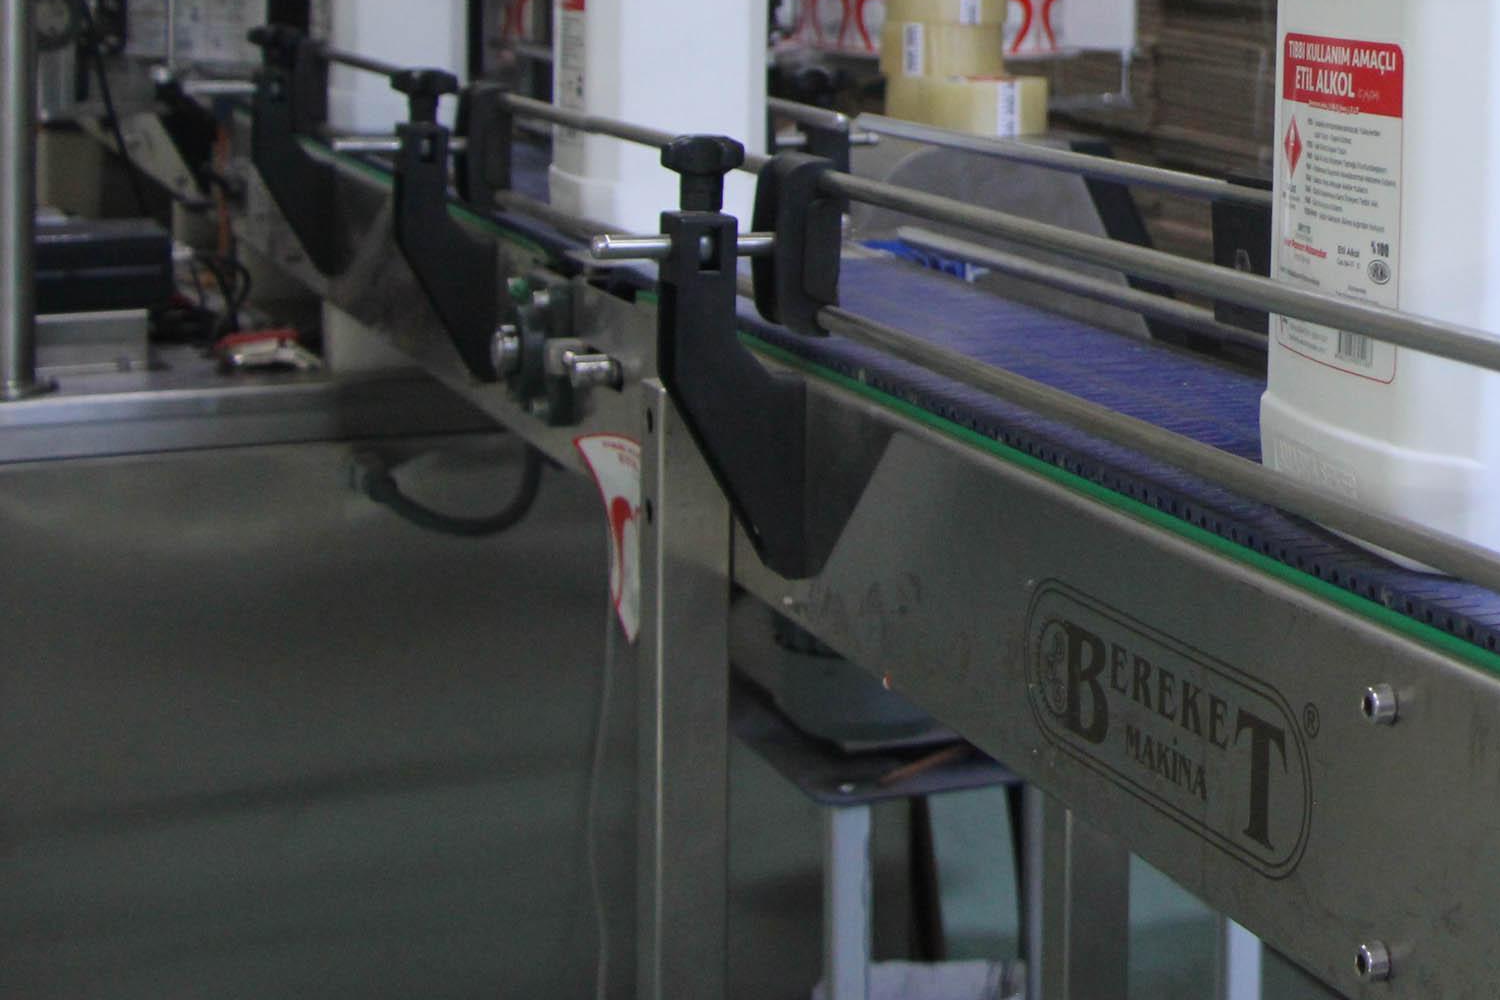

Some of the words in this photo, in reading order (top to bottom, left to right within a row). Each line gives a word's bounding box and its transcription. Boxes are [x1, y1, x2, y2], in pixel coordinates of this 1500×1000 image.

[1306, 42, 1350, 67] KULLANIM
[1351, 47, 1396, 76] AMAÇLI
[1315, 69, 1356, 99] ALKOL
[1064, 619, 1288, 852] BEREKET
[1124, 724, 1208, 801] MAKİNA
